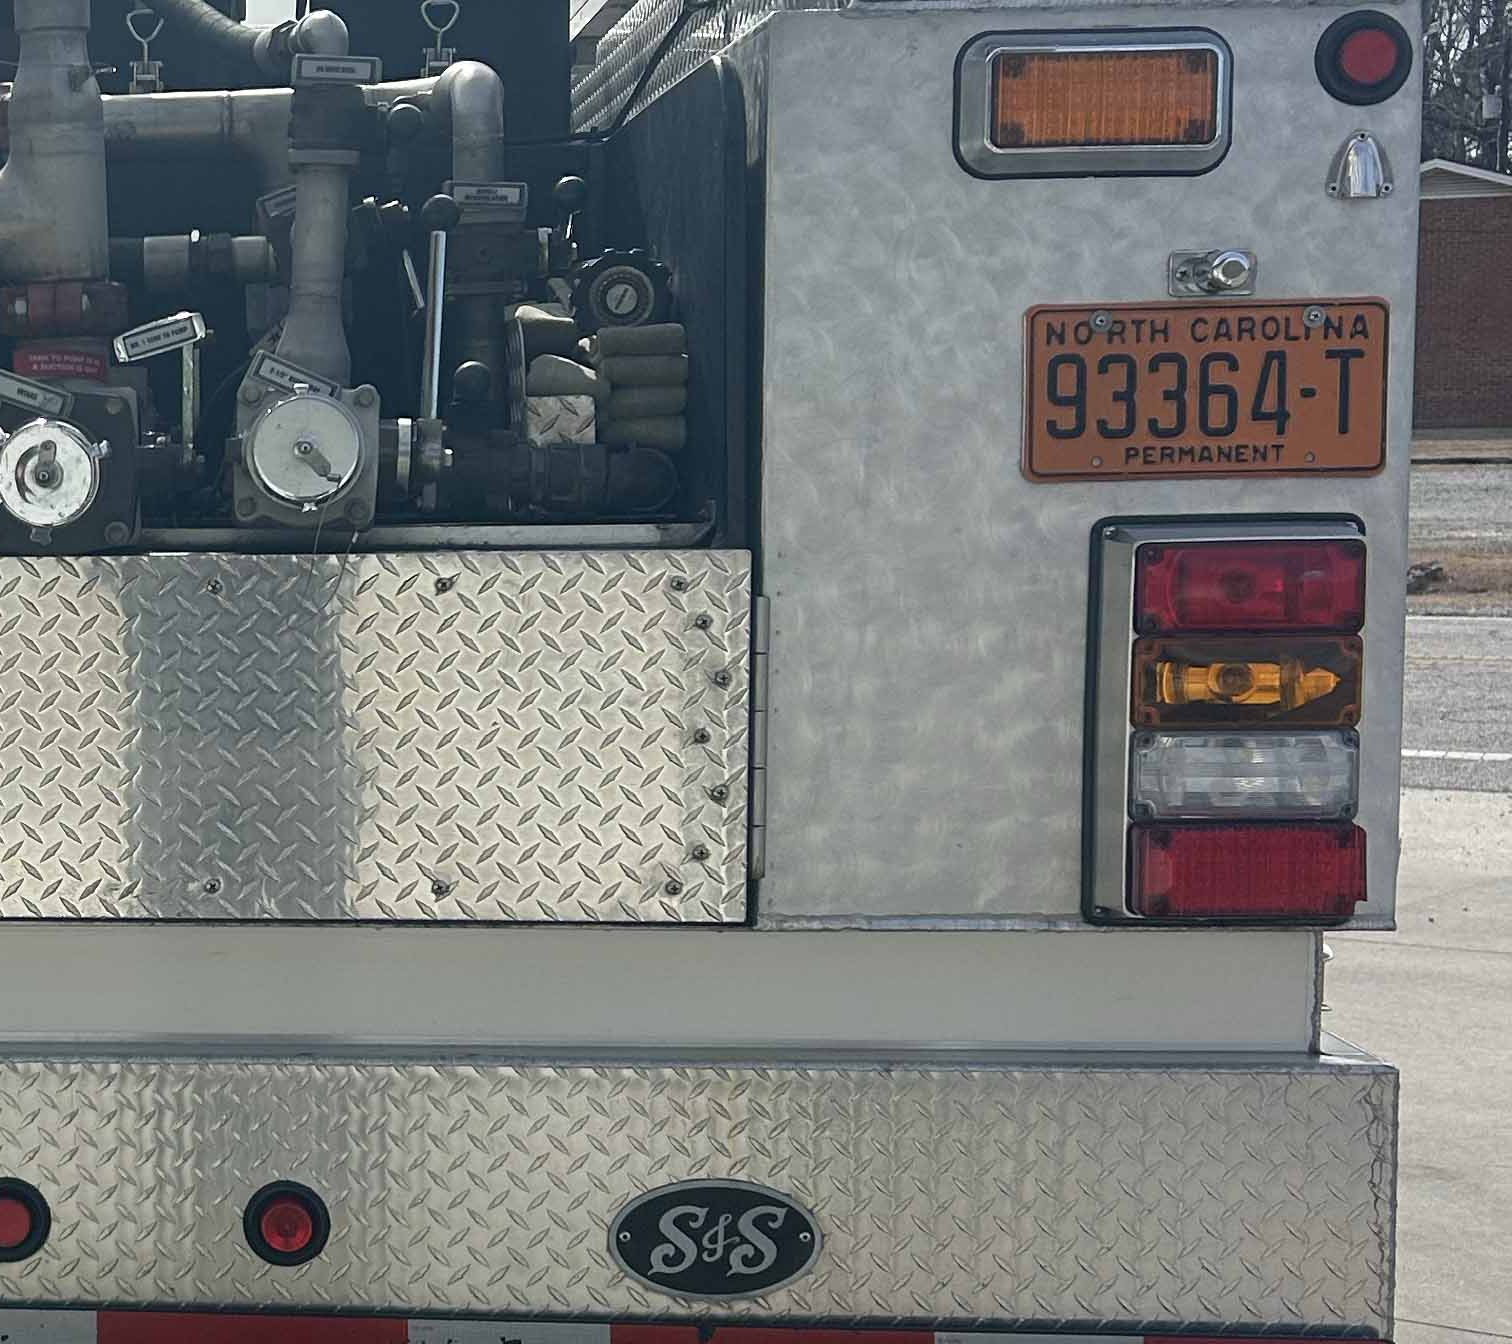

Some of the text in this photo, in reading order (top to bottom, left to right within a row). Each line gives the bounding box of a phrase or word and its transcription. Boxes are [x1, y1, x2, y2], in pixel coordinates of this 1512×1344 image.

[1045, 313, 1370, 345] NORTH CAROLINA
[1045, 347, 1366, 440] 93364-T
[1124, 443, 1286, 466] PERMANENT
[648, 1205, 788, 1277] S&S
